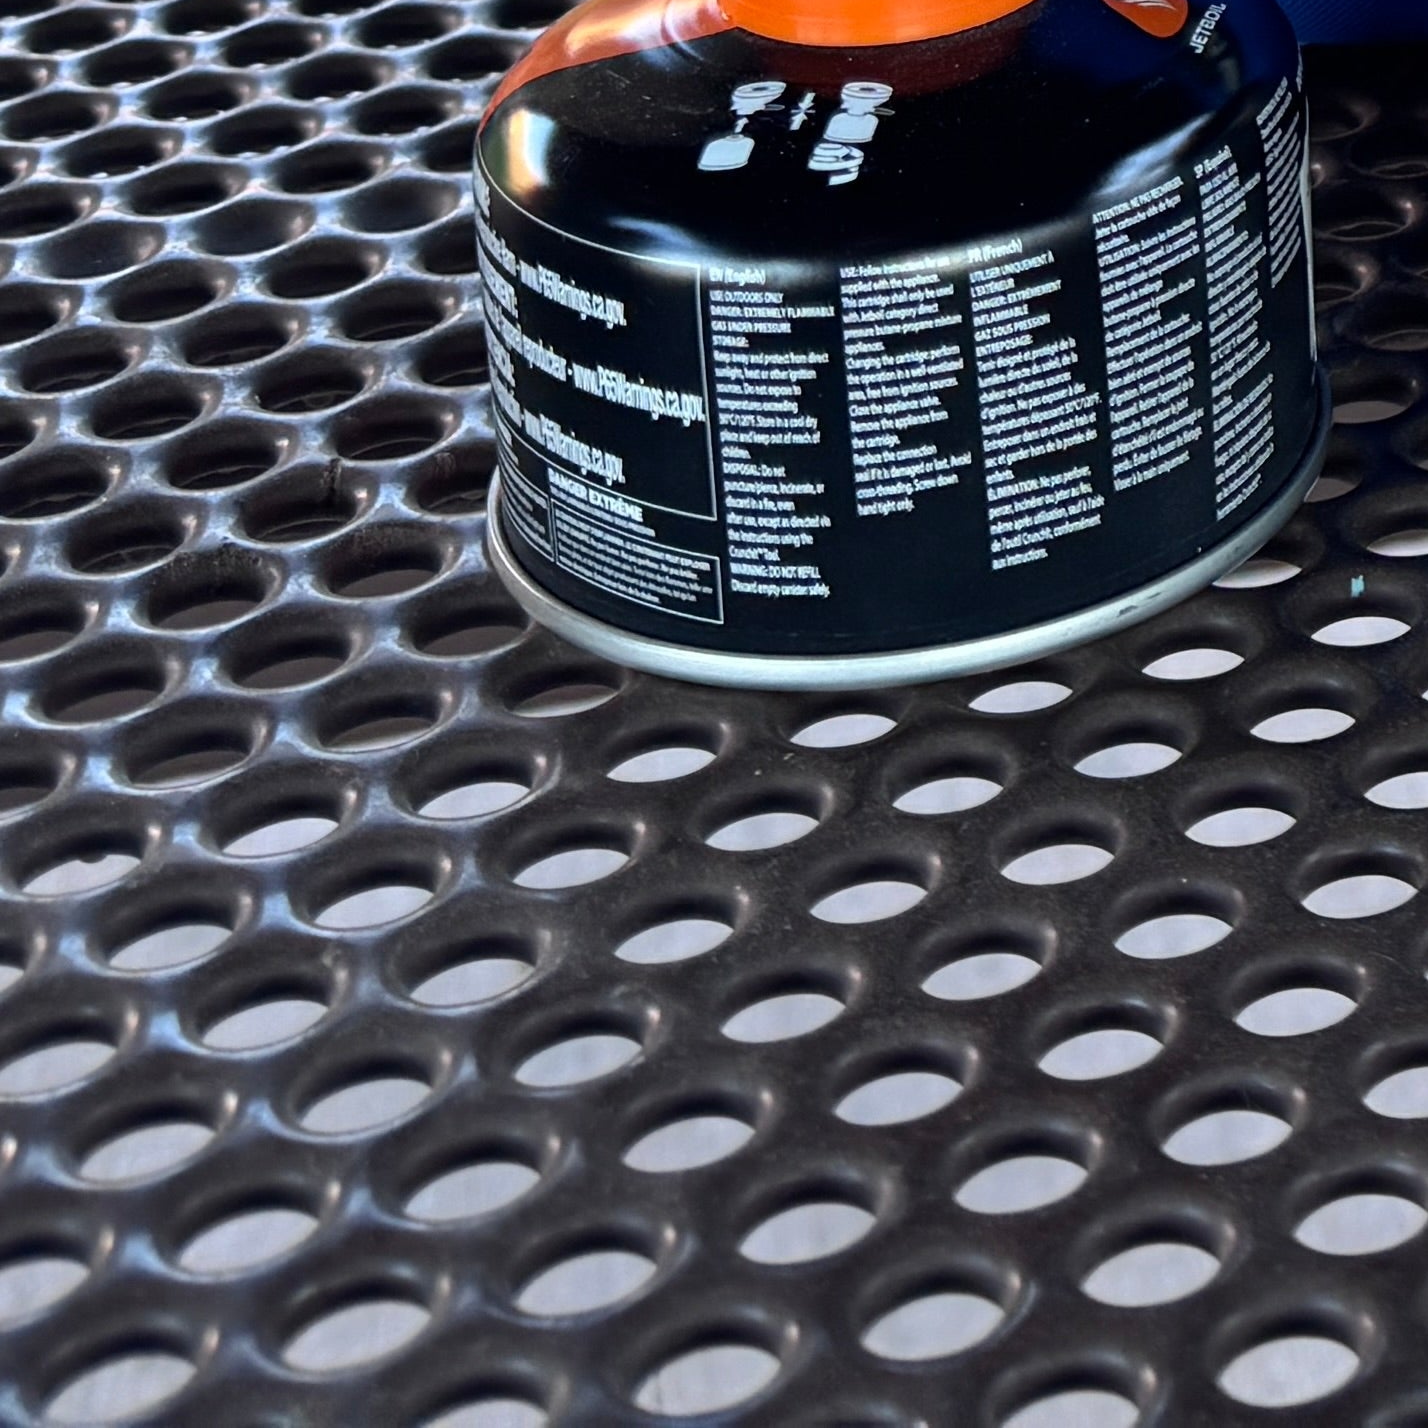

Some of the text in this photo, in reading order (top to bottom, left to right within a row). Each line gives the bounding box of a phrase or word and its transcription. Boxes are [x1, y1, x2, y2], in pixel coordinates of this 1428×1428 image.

[1189, 2, 1227, 54] JETBOIL
[983, 238, 1023, 262] (French)
[725, 267, 766, 286] (English)
[890, 278, 903, 289] the
[725, 291, 763, 303] OUTDOORS
[973, 303, 1029, 327] INFLAMMABLE
[750, 352, 763, 364] and
[572, 361, 706, 428] www.P65Warnings.ca.gov.
[547, 467, 588, 502] DANGER
[588, 487, 644, 522] EXTRÊME
